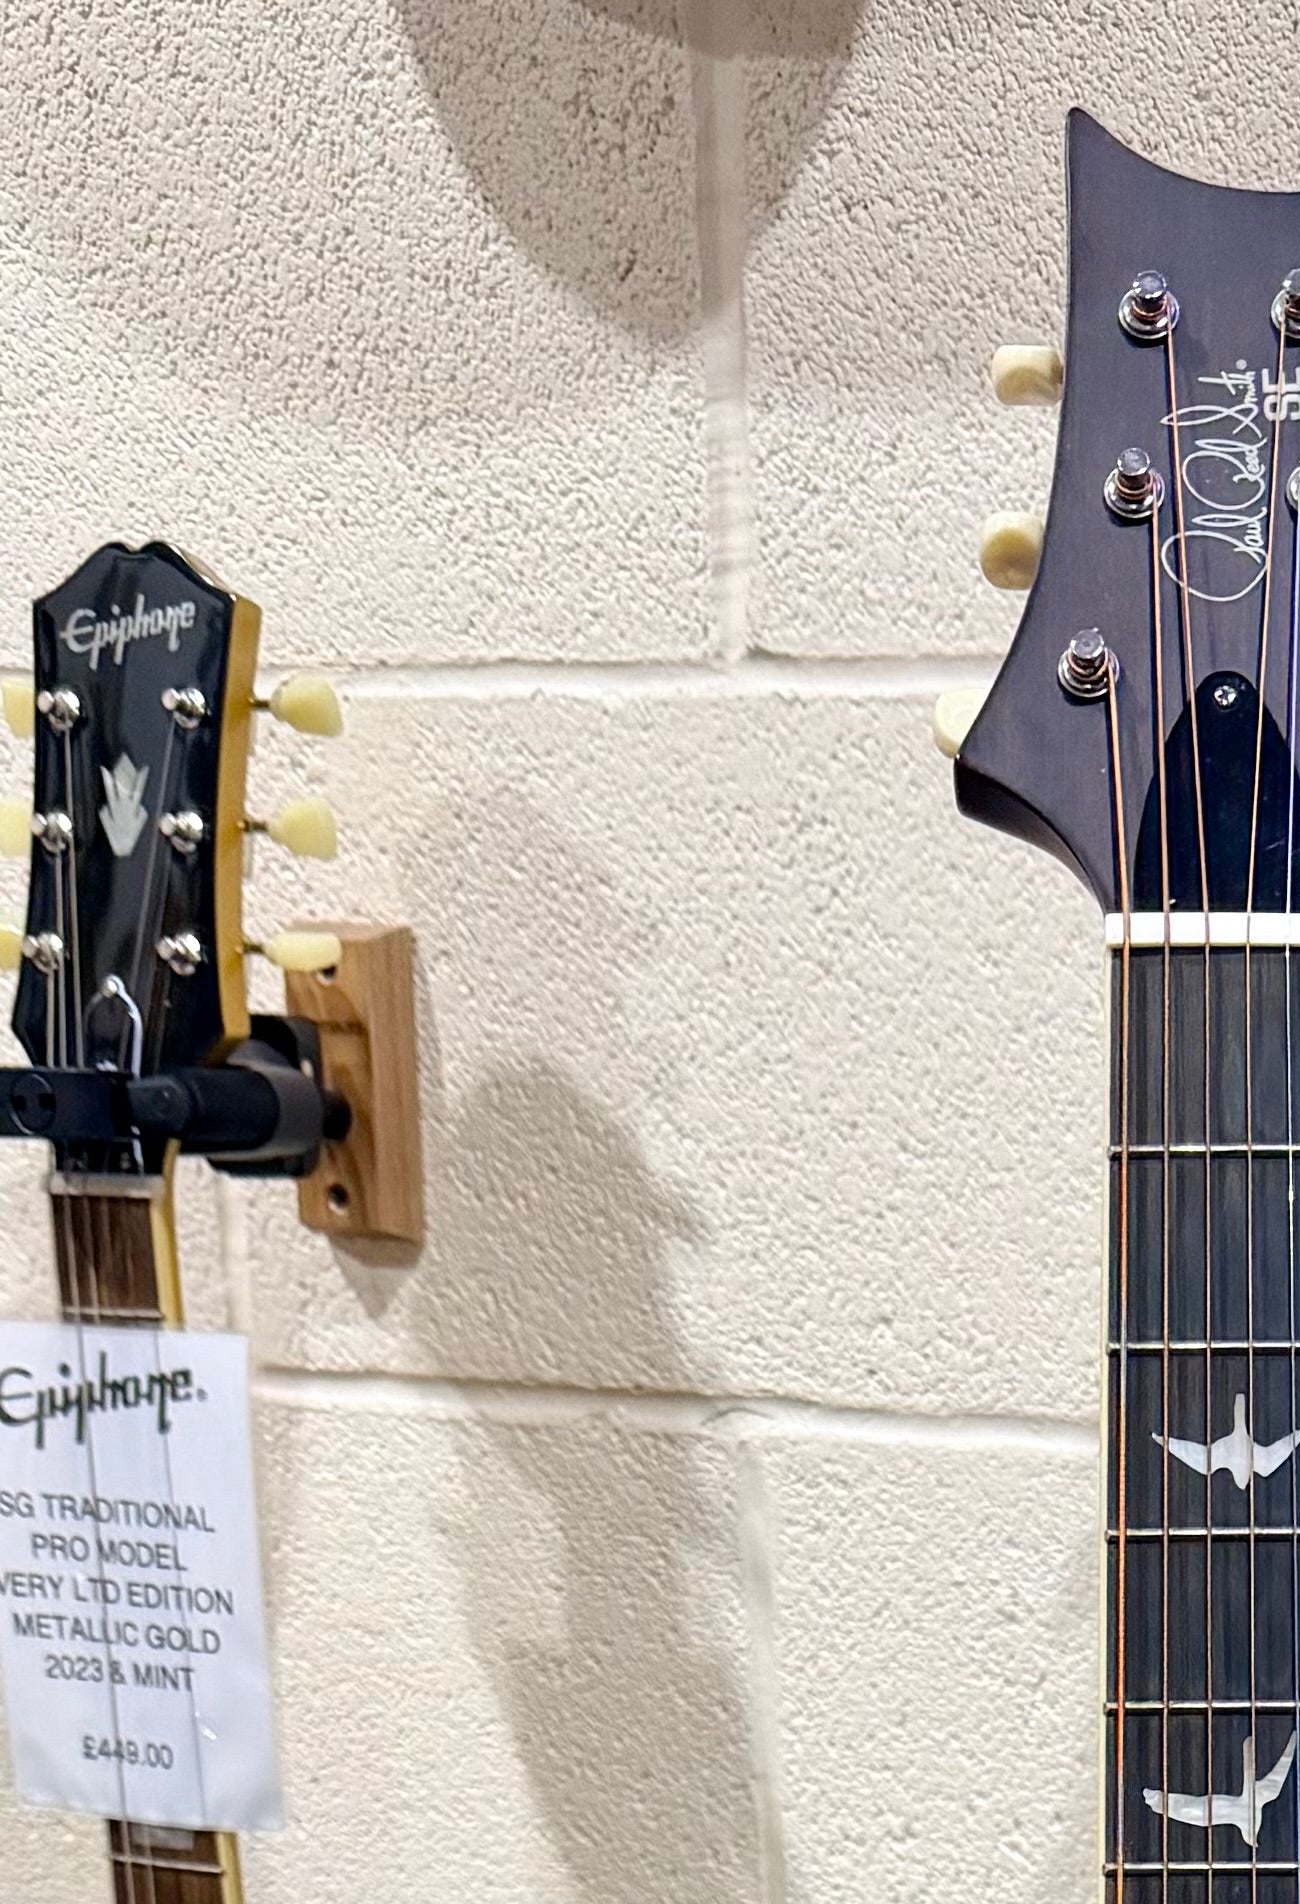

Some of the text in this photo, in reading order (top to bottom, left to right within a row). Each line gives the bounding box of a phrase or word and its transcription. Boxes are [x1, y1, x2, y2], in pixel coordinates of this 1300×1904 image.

[59, 593, 196, 671] Epiphone
[0, 1491, 215, 1533] SG TRADITIONAL
[32, 1533, 188, 1571] PRO MODEL
[73, 1575, 120, 1606] LTD
[127, 1582, 234, 1616] EDITION
[13, 1612, 221, 1655] METALLIC GOLD
[45, 1654, 195, 1692] 2023 & MINT
[82, 1735, 174, 1770] £449.00
